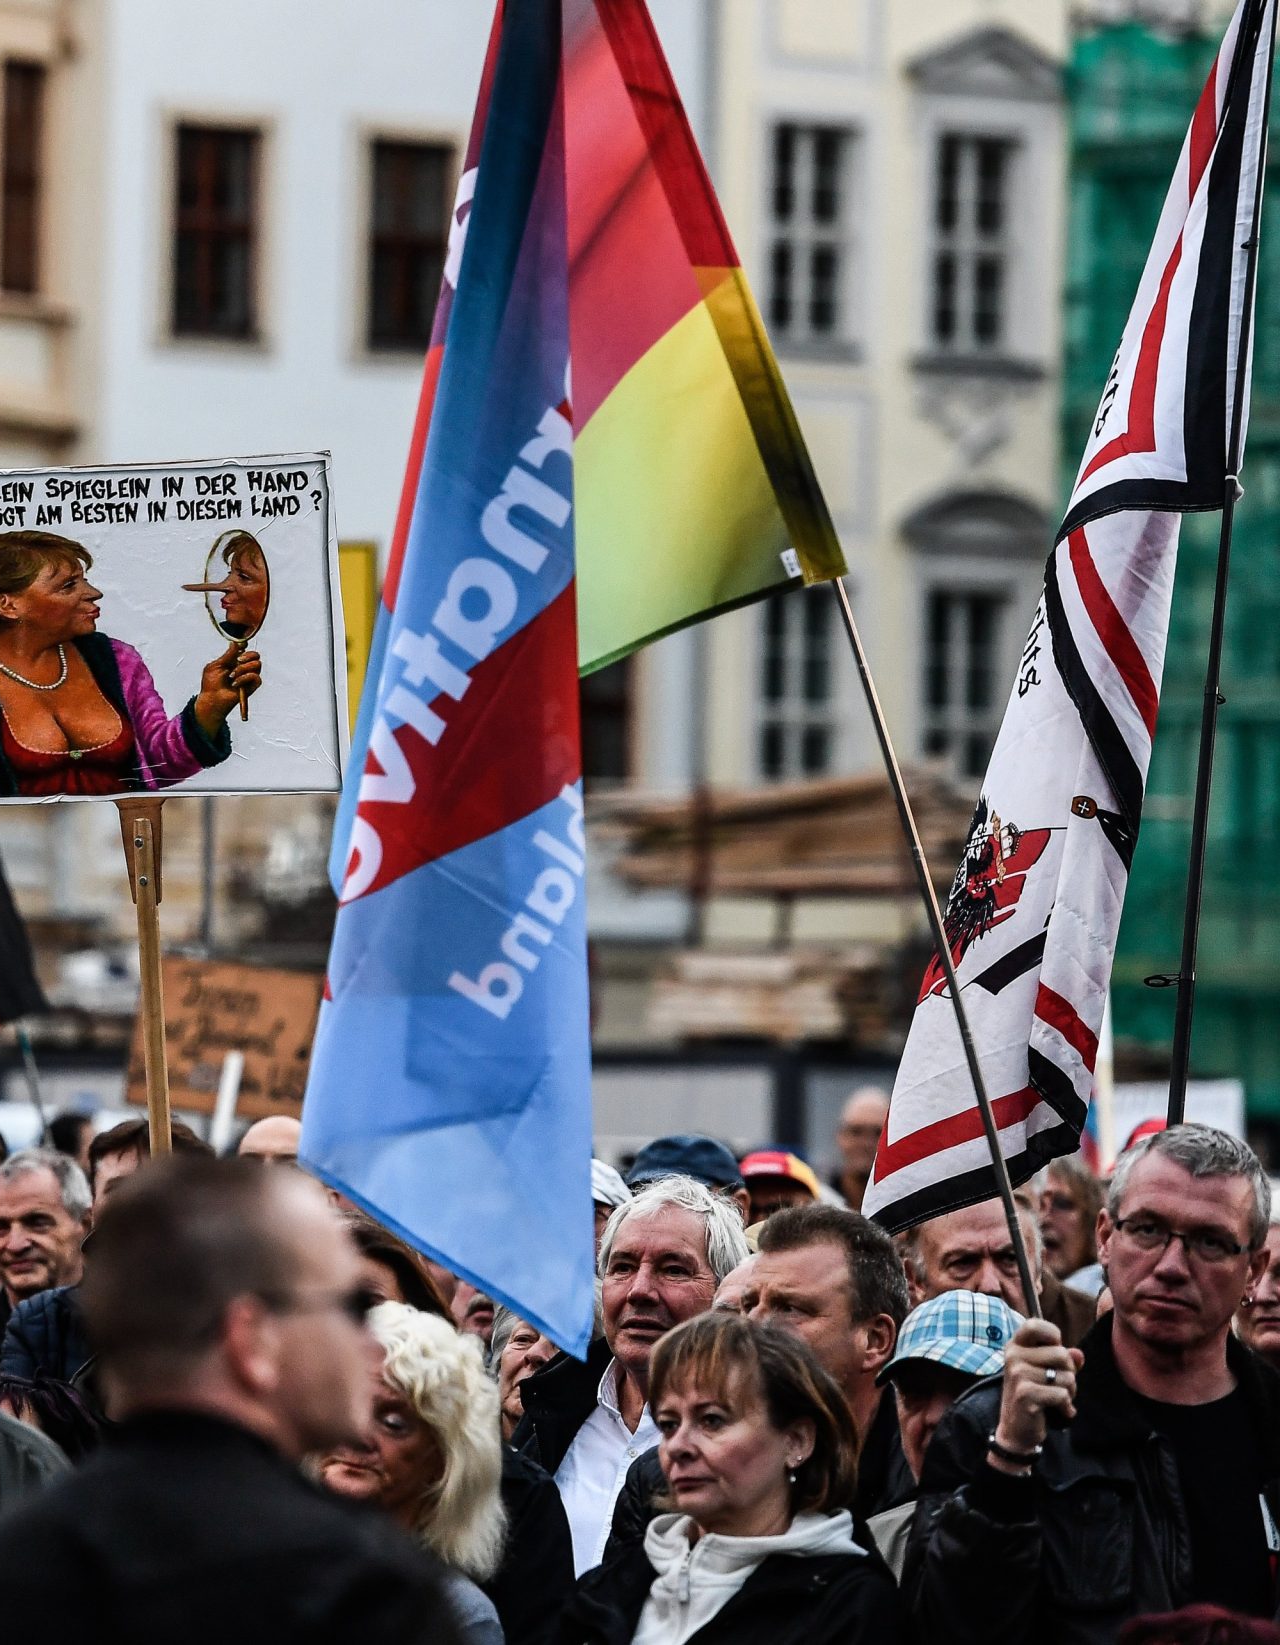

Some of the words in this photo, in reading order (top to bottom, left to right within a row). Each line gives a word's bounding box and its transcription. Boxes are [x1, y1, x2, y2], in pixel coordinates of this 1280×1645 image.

[45, 477, 151, 501] SPIEGLEIN
[162, 476, 184, 498] IN
[195, 473, 237, 496] DER
[247, 471, 309, 493] HAND
[36, 504, 63, 526] AM
[71, 501, 138, 524] BESTEN
[148, 501, 167, 523] IN
[176, 499, 242, 521] DIESEM
[251, 495, 301, 518] LAND
